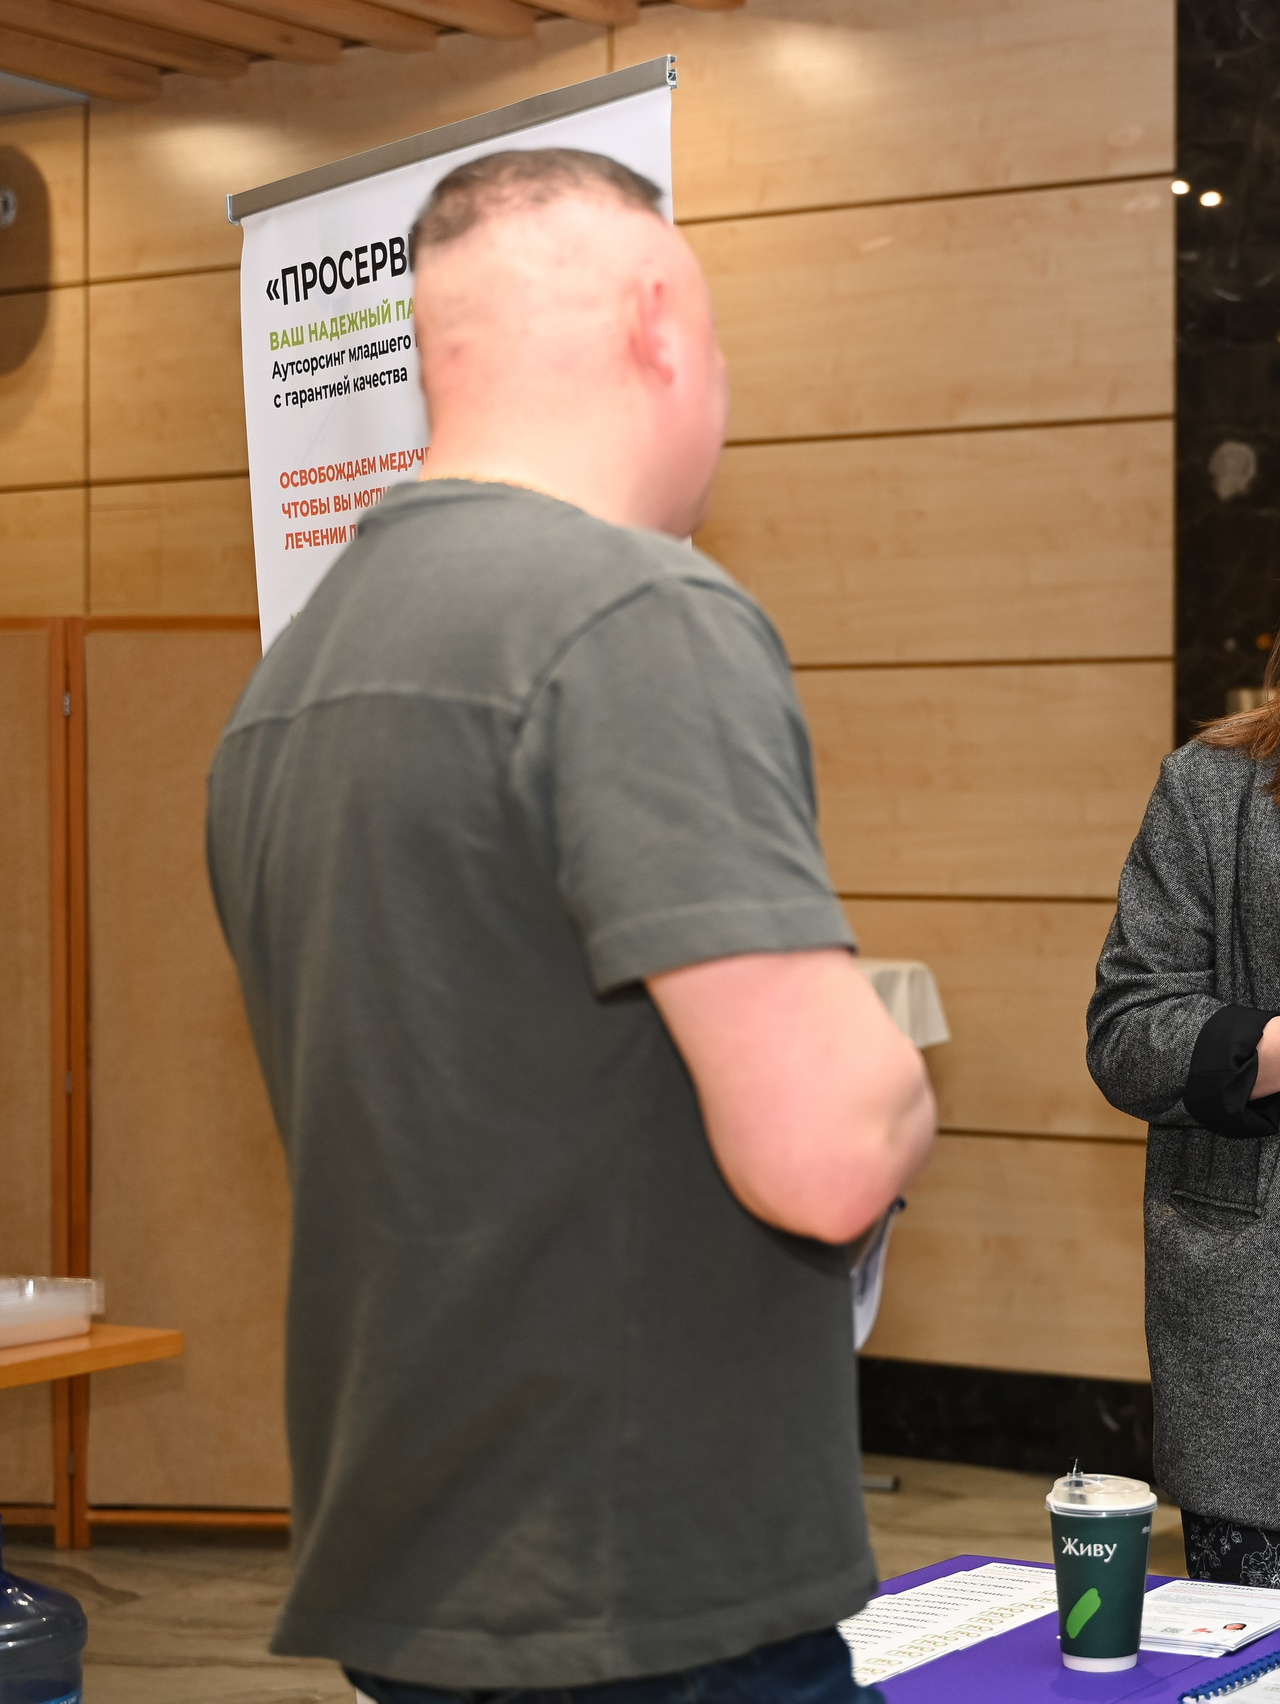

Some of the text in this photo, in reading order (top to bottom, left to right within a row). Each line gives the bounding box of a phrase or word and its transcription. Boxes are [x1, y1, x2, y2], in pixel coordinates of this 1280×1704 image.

[266, 233, 413, 305] «ПРОСЕРВ
[269, 325, 304, 351] ВАШ
[308, 299, 392, 343] НАДЕЖНЫЙ
[272, 350, 346, 382] Аутсорсинг
[349, 335, 411, 363] младшего
[273, 366, 408, 408] с гарантией качества
[279, 456, 377, 489] ОСВОБОЖДАЕМ
[281, 497, 330, 519] ЧТОБЫ
[333, 493, 352, 513] ВЫ
[284, 525, 347, 551] ЛЕЧЕНИИ
[1061, 1536, 1118, 1563] Живу
